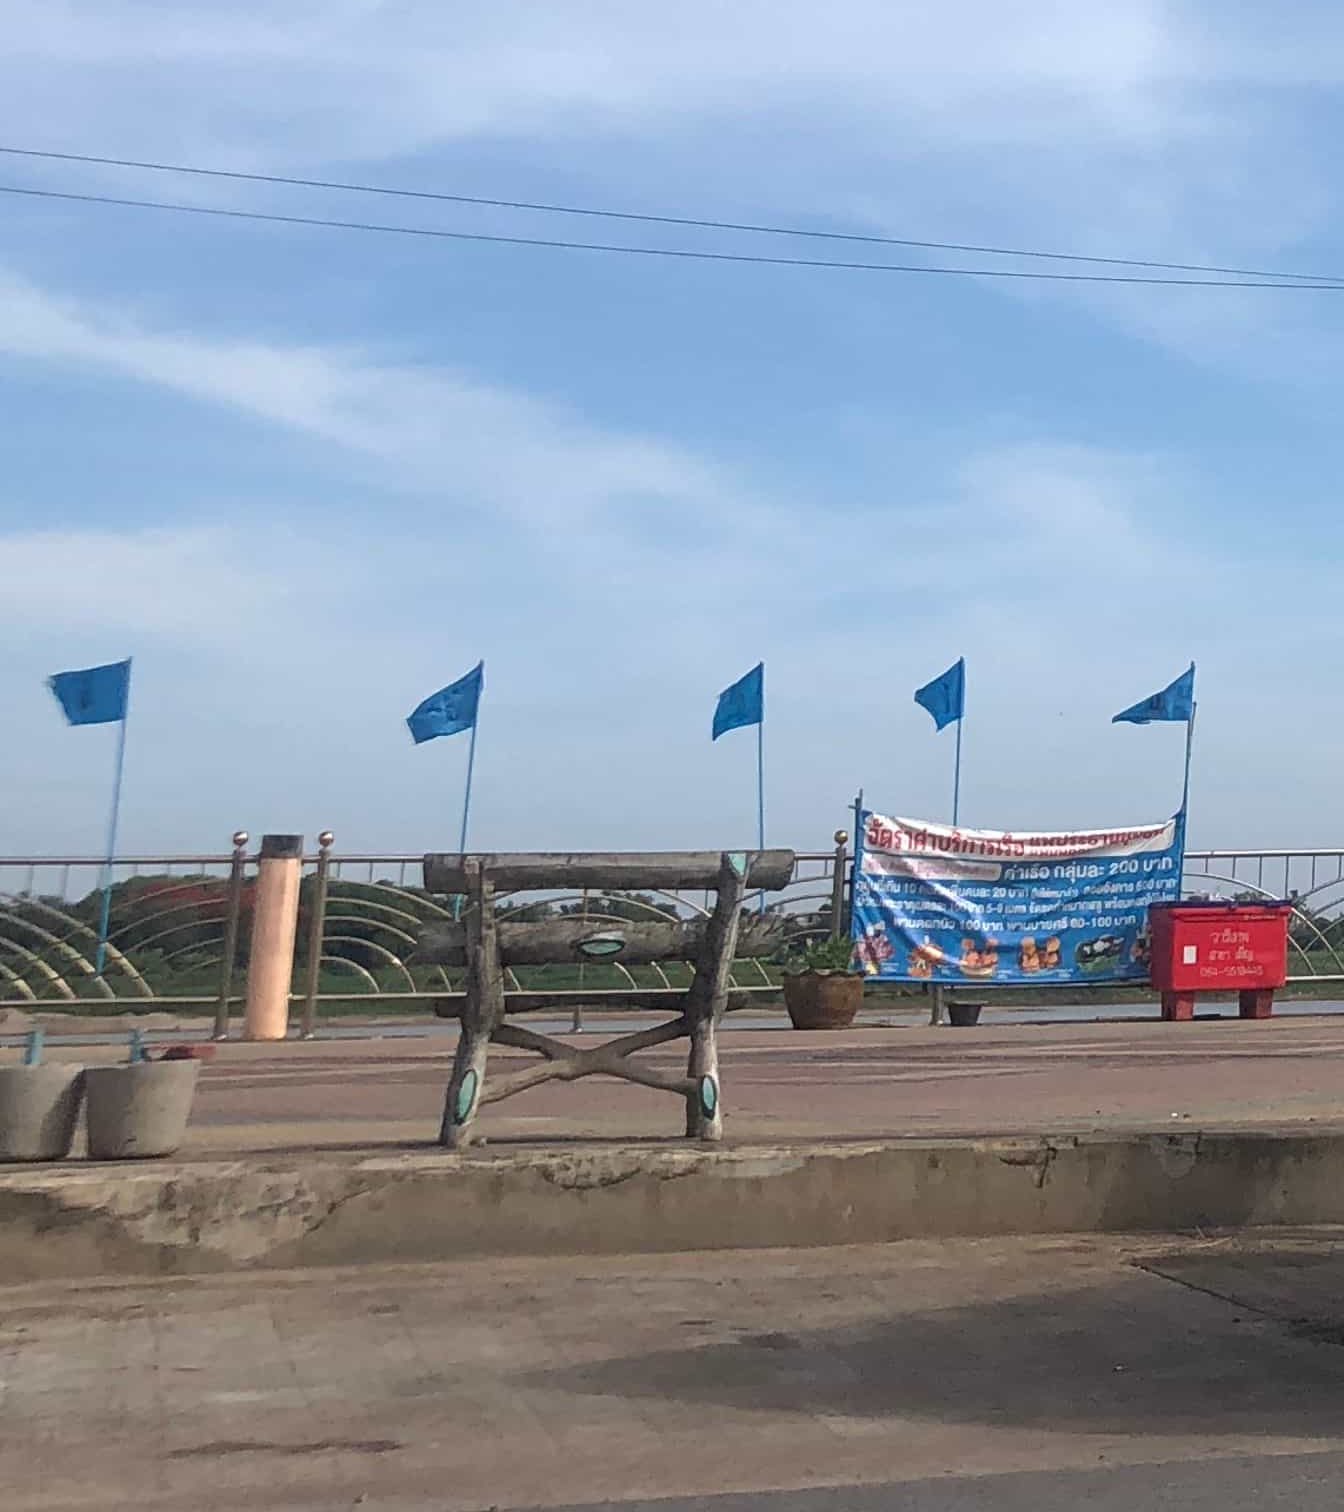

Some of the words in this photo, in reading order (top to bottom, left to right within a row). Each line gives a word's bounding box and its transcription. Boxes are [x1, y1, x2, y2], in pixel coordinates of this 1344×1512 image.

[1109, 860, 1139, 875] 200
[1143, 856, 1173, 871] บาท
[960, 919, 981, 931] 100
[982, 920, 1004, 932] บาท
[1114, 914, 1136, 926] บาท
